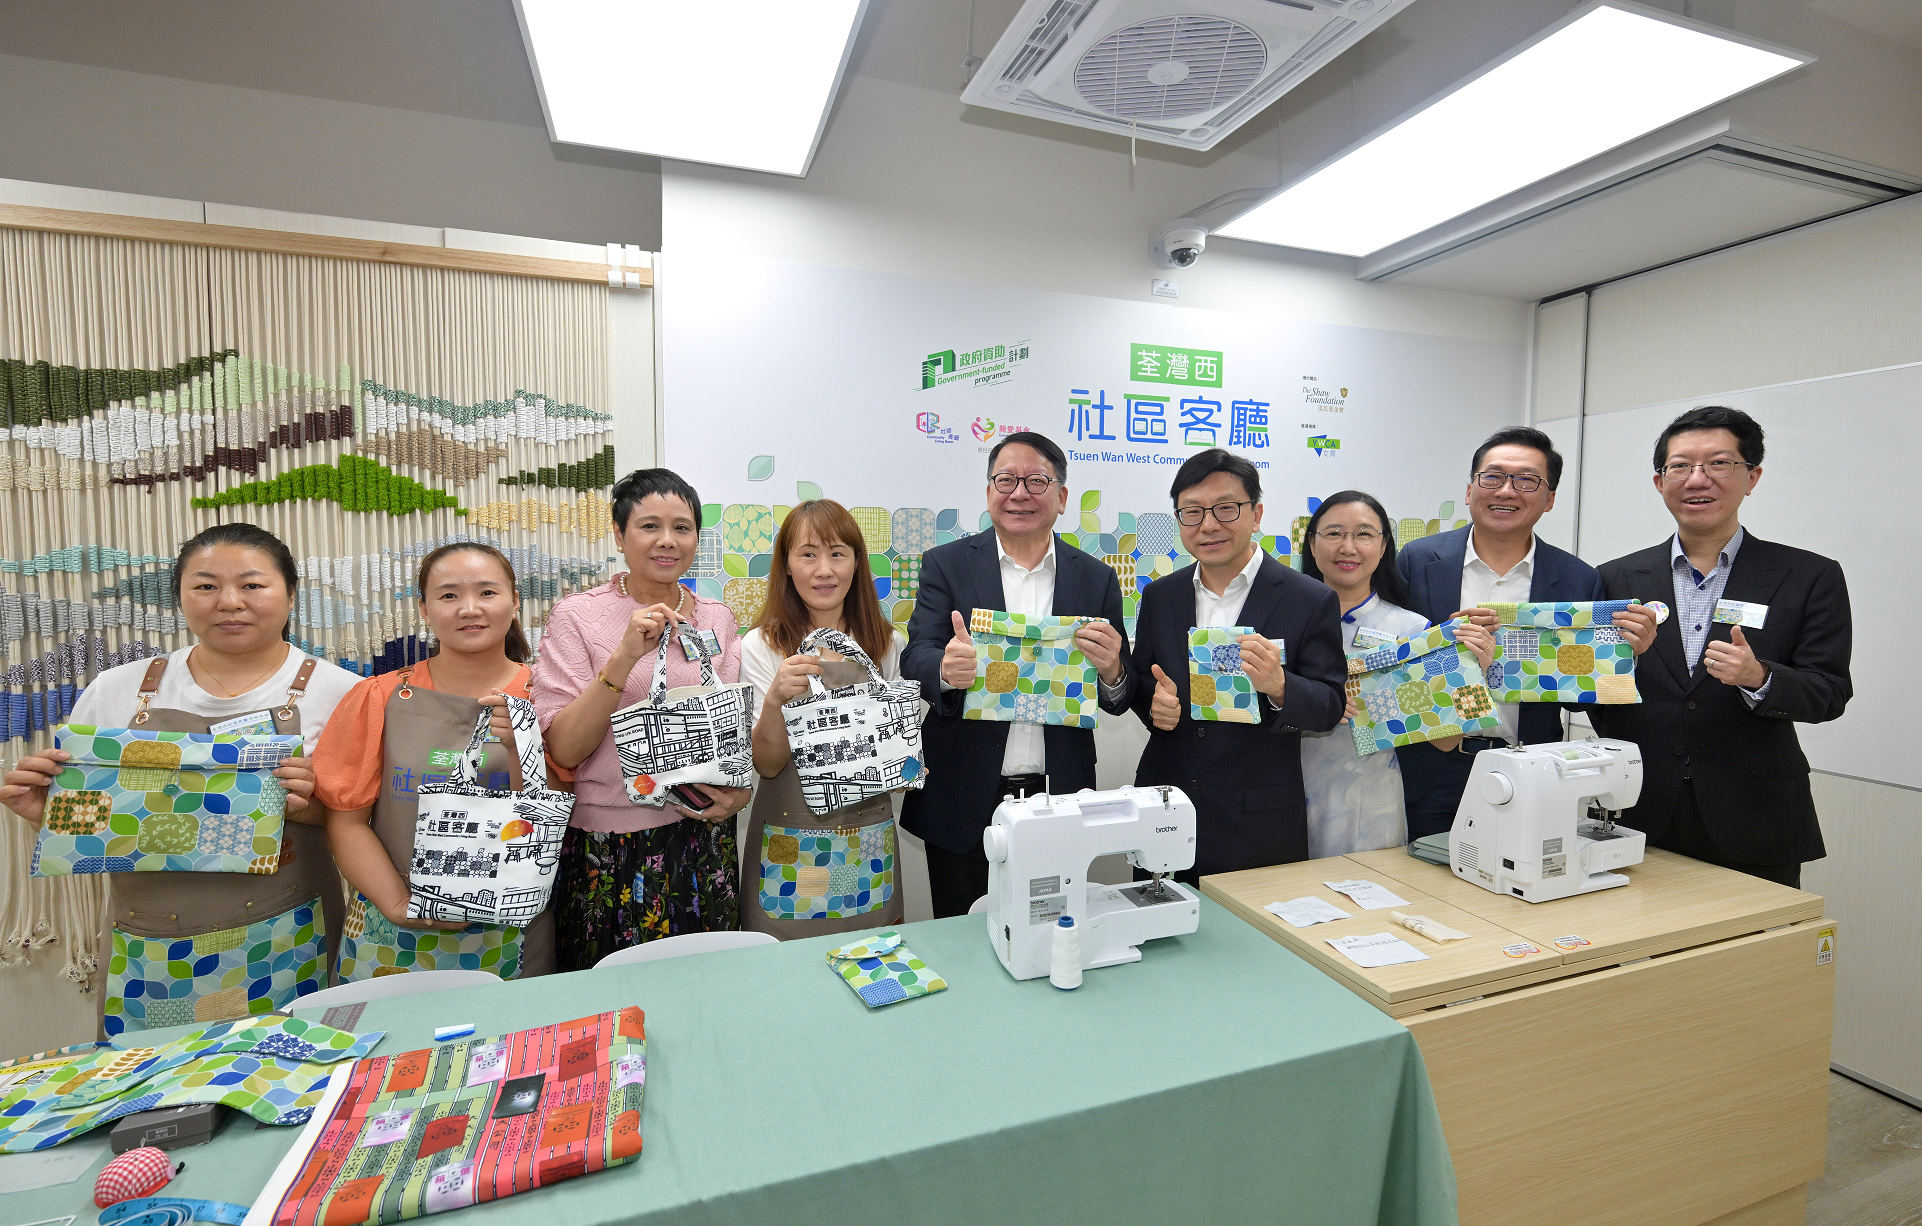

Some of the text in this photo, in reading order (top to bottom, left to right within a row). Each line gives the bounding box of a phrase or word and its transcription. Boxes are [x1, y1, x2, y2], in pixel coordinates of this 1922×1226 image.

[960, 345, 1029, 367] 政府資助 計劃
[1137, 350, 1218, 381] 荃灣西
[938, 362, 1006, 385] Government-funded
[974, 370, 1011, 385] programme
[1311, 388, 1331, 397] Shaw
[1305, 394, 1345, 405] Foundation
[1068, 388, 1270, 449] 社區客廳
[1312, 439, 1336, 448] YWCA
[1068, 450, 1099, 462] Tsuen
[1101, 452, 1124, 463] Wan
[1126, 453, 1151, 464] West
[1323, 450, 1336, 458] 文青
[428, 820, 480, 833] 社區客廳
[1155, 825, 1178, 833] brother
[116, 1205, 127, 1214] 54
